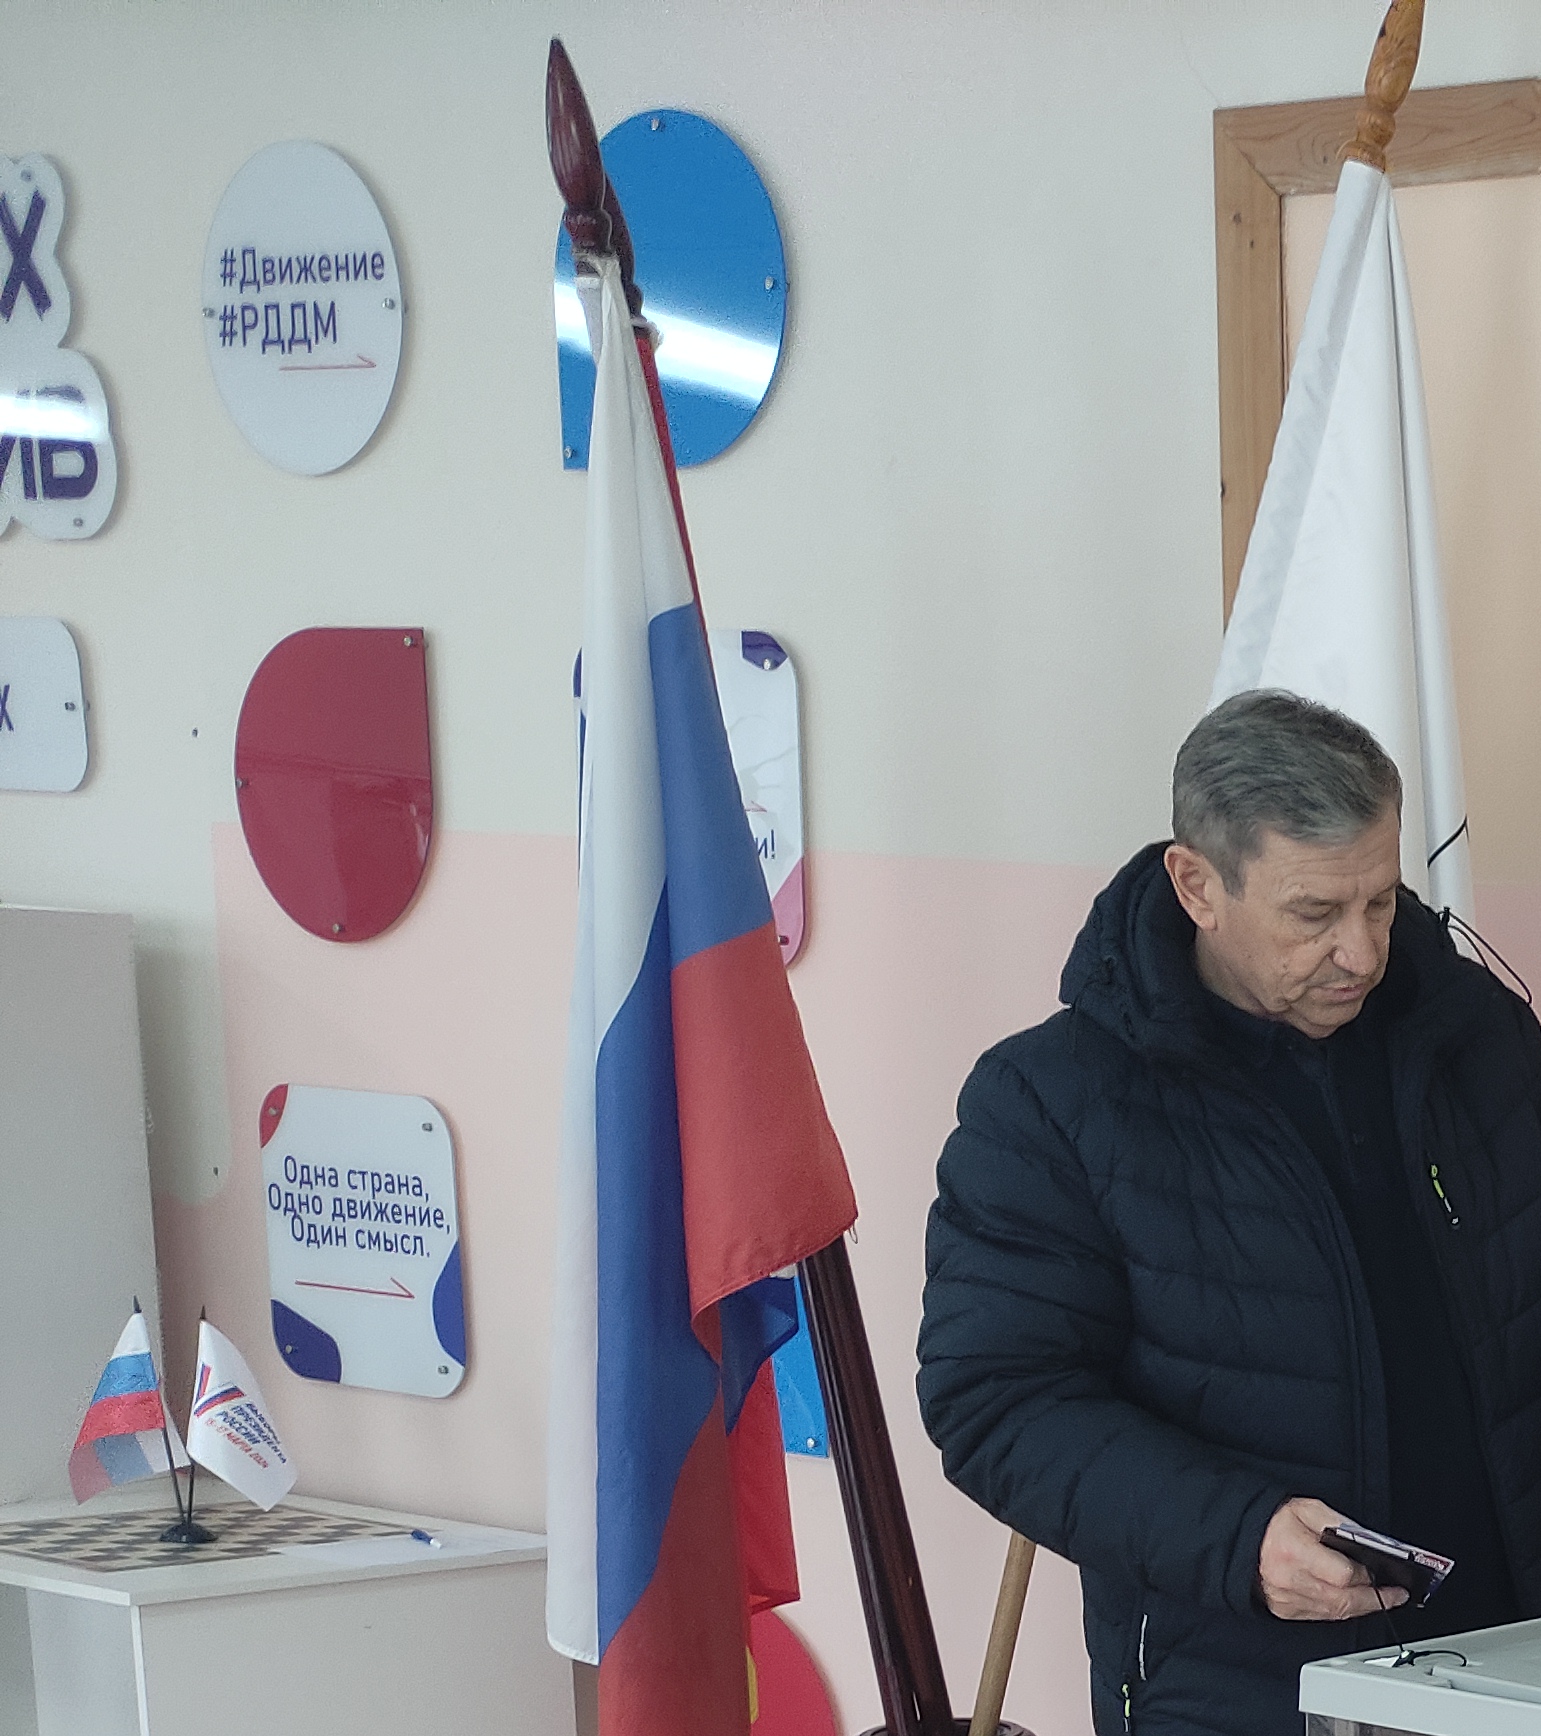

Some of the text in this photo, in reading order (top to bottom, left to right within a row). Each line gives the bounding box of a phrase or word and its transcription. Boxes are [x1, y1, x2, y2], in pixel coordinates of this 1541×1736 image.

[219, 245, 386, 295] #Движение
[218, 300, 339, 355] #РДДМ
[283, 1153, 431, 1204] Одна страна,
[268, 1181, 452, 1236] Одно движение,
[289, 1212, 432, 1259] Один смысл.
